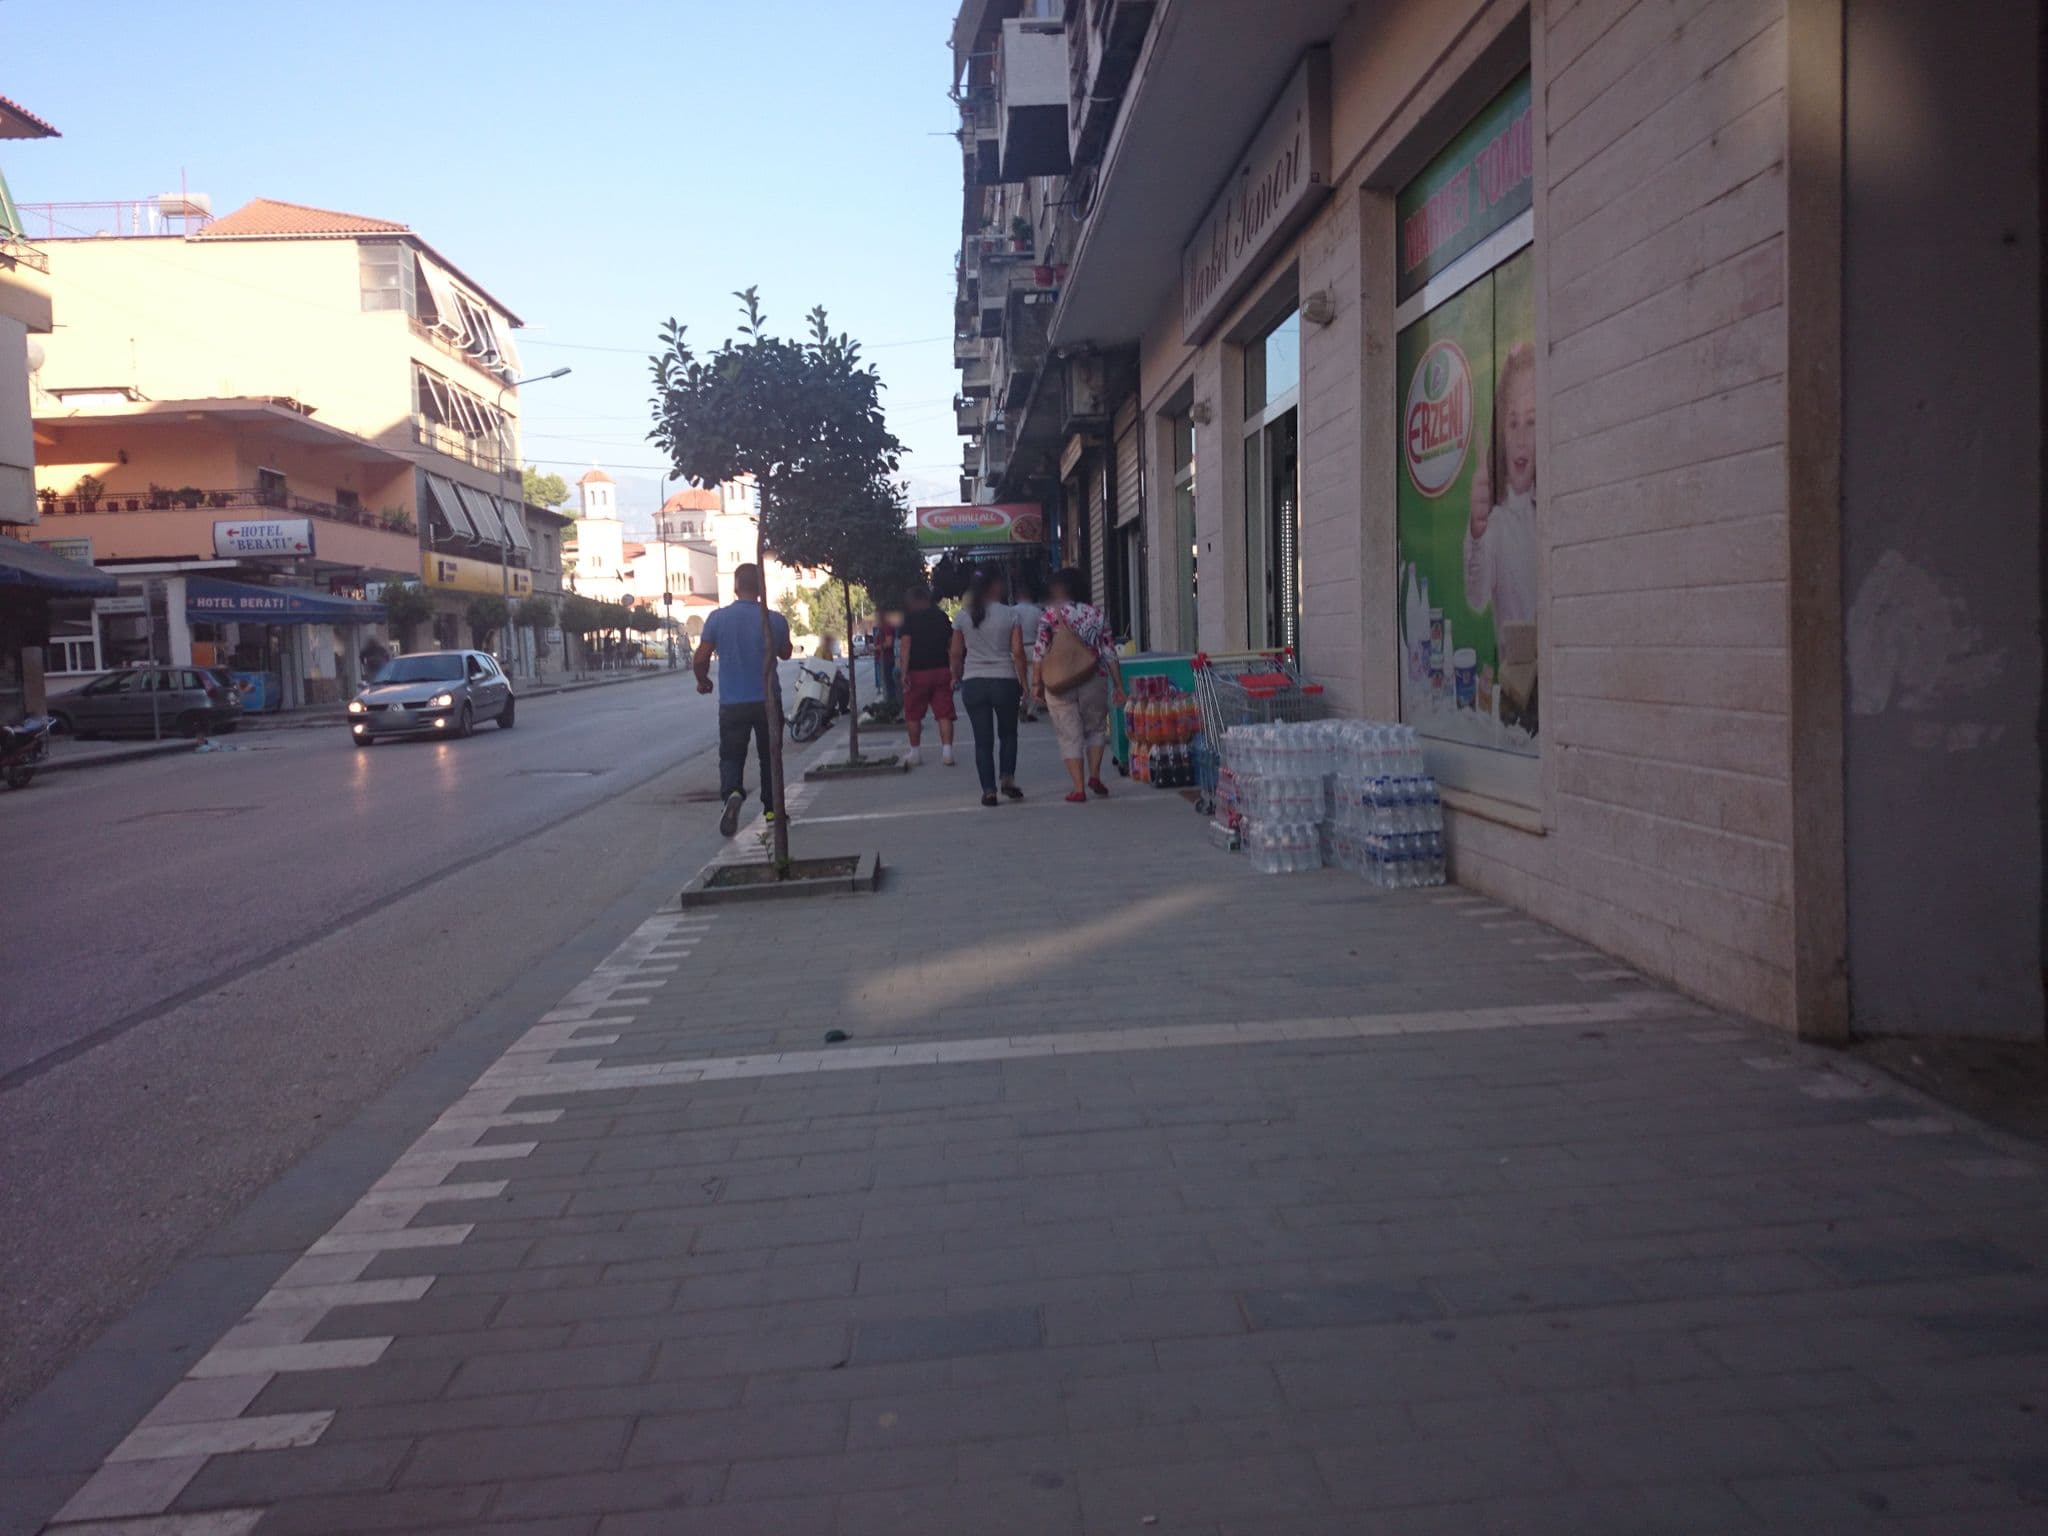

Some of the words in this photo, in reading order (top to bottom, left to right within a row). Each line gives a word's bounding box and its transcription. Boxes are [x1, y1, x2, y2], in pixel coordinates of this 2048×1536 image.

[1404, 163, 1471, 275] MARKET
[240, 525, 283, 537] HOTEL
[196, 598, 236, 608] HOTEL
[240, 598, 284, 609] BERATI
